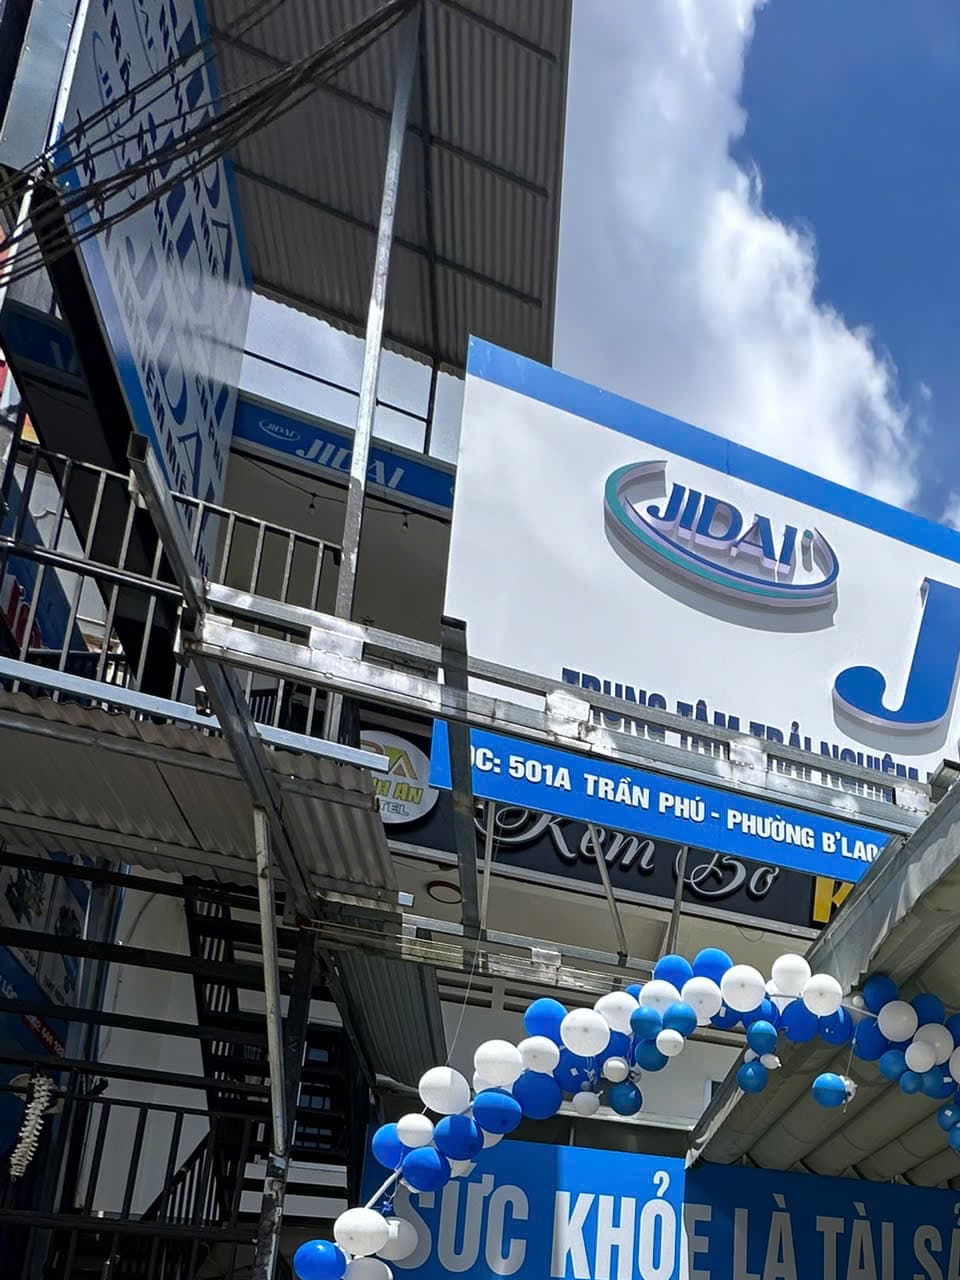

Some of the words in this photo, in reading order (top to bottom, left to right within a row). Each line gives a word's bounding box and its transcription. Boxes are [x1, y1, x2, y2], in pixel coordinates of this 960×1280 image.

[646, 483, 796, 570] JIDAI
[470, 745, 502, 774] C:
[508, 755, 571, 791] 501A
[584, 774, 649, 811] TRẦN
[659, 791, 705, 823] PHÚ
[727, 810, 815, 850] PHƯỜNG
